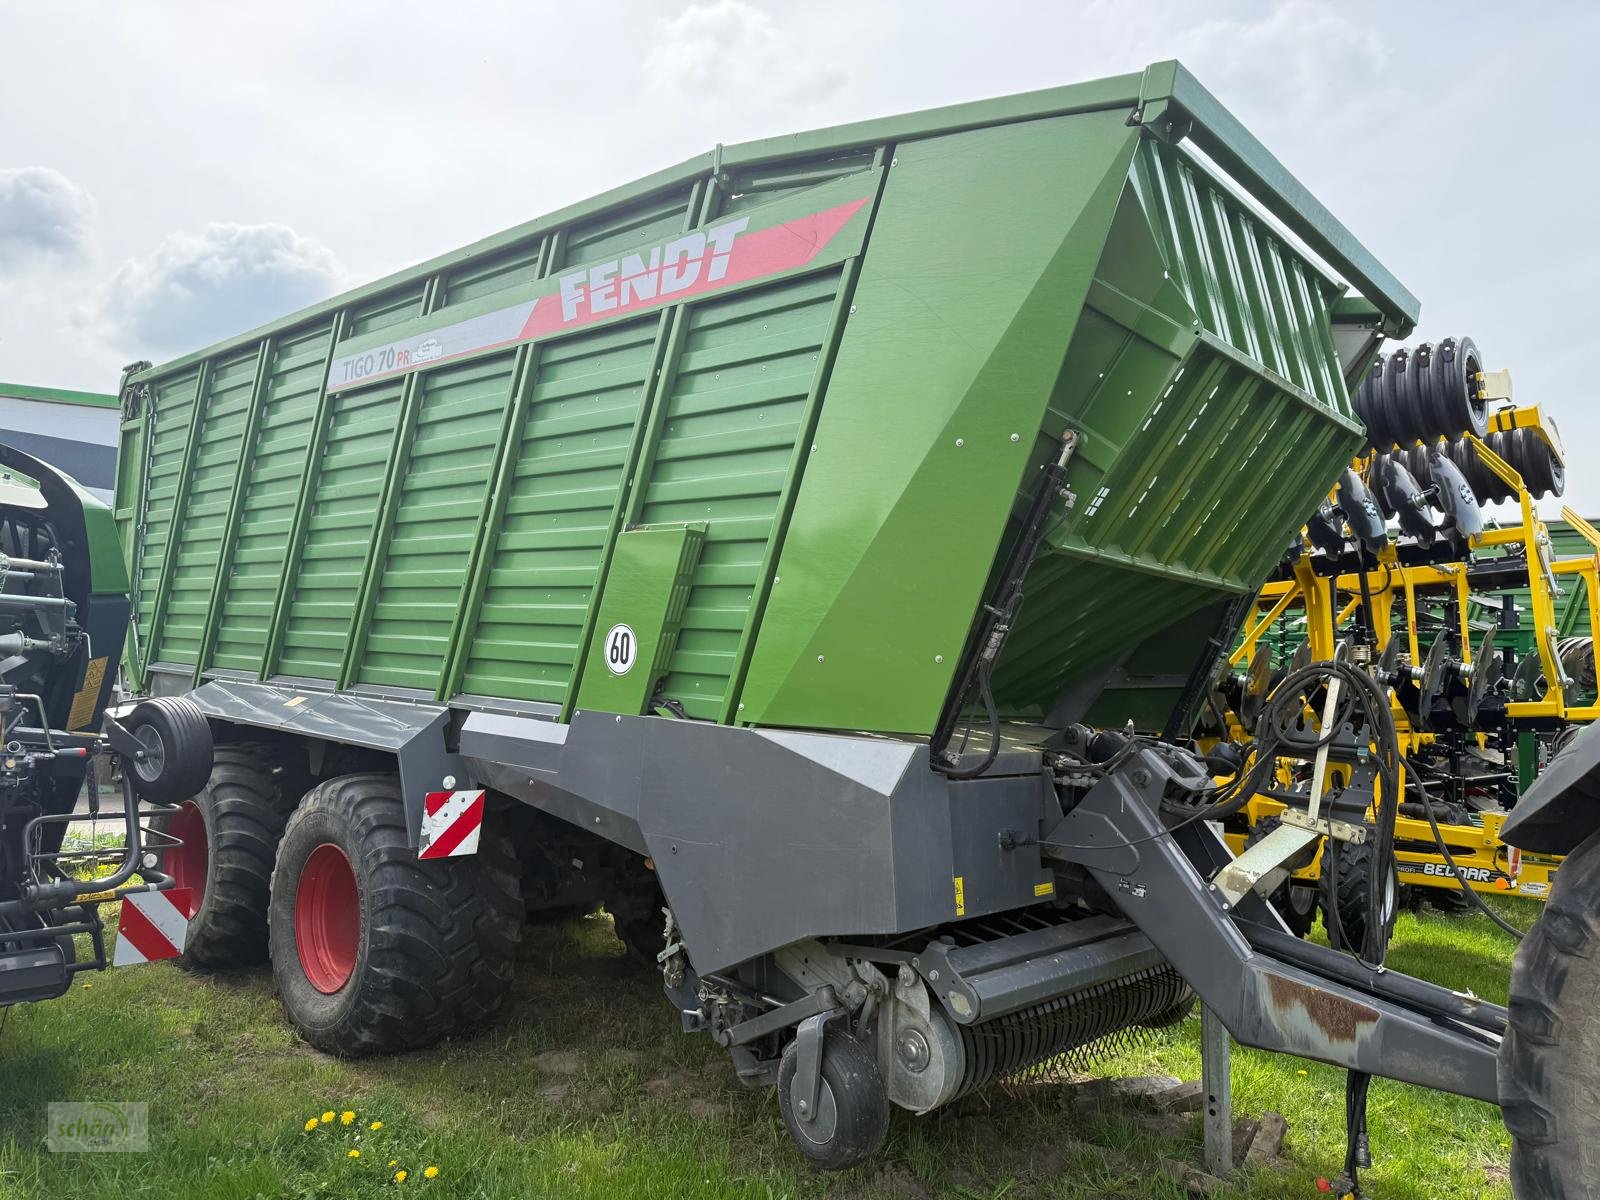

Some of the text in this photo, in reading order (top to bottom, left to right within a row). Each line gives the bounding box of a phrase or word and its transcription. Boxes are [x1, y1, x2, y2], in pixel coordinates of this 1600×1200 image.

[559, 216, 750, 322] FENDT
[343, 354, 374, 381] TIGO
[377, 346, 396, 372] 70
[396, 350, 410, 367] PR
[610, 632, 630, 665] 60
